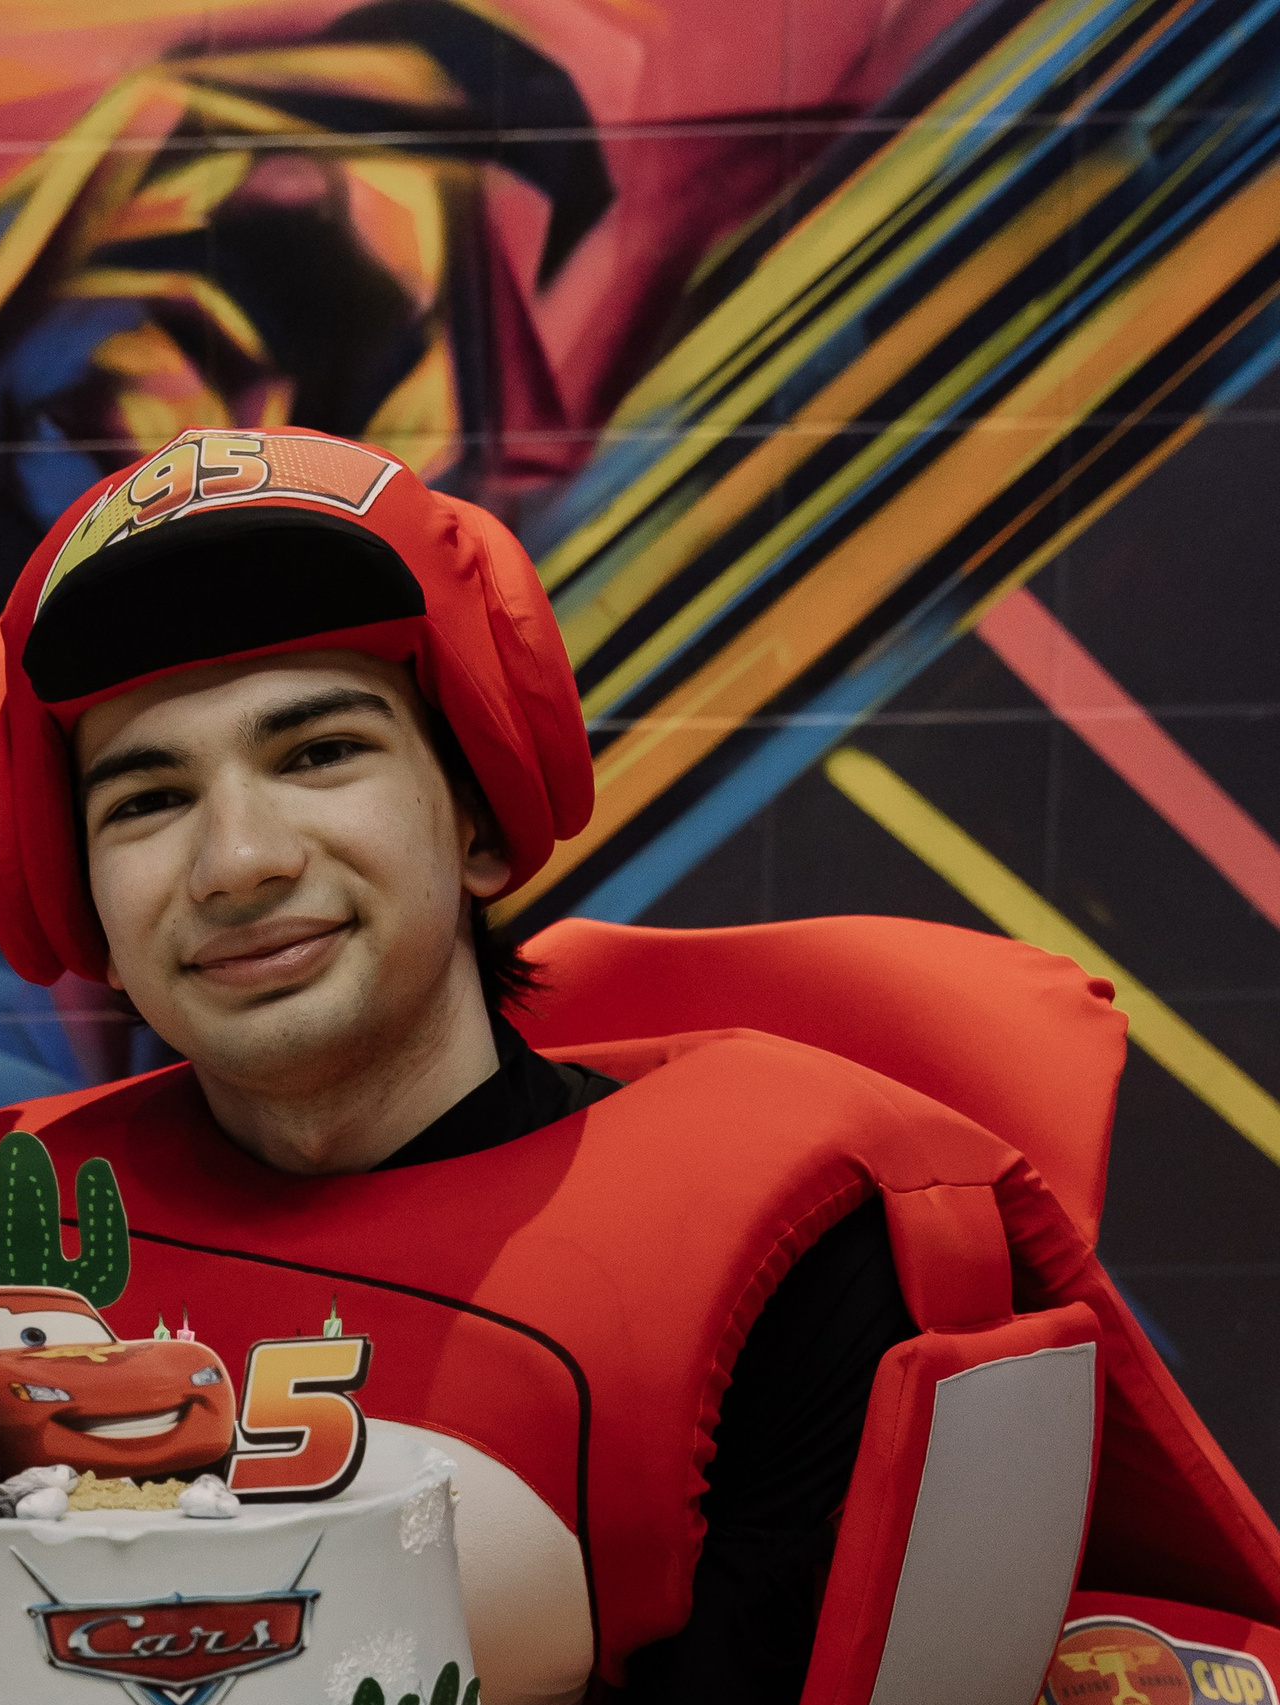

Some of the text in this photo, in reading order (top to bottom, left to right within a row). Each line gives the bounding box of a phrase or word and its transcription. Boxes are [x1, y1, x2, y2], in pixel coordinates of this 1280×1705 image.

[128, 436, 270, 525] 95
[227, 1334, 371, 1502] 5
[68, 1613, 280, 1658] Cars
